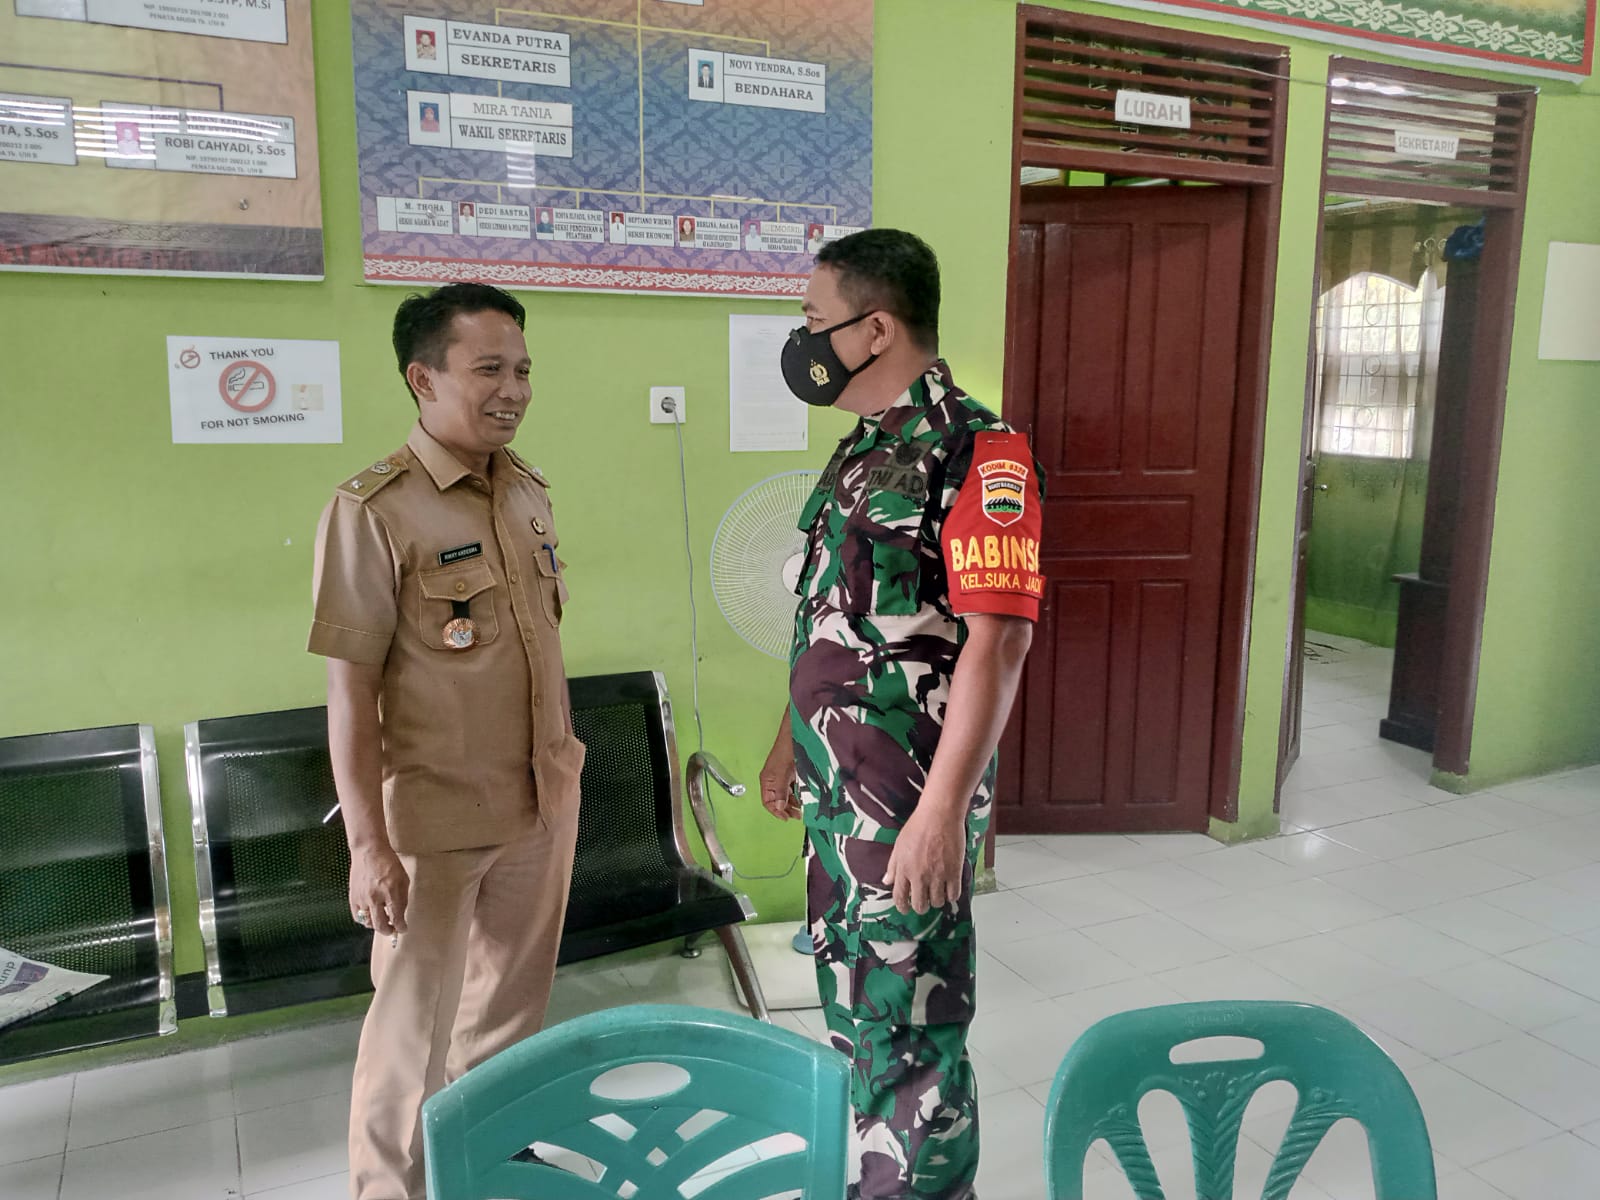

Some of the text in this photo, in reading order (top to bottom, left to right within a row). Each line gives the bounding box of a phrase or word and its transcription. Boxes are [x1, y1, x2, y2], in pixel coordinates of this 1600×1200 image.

[453, 28, 562, 51] EVANDA PUTRA
[461, 54, 557, 74] SEKRETARIS
[729, 59, 820, 79] NOVI YENDRA, S.Sos
[735, 82, 814, 100] BENDAHARA
[473, 102, 553, 120] MIRA TANIA
[1123, 98, 1183, 122] LURAH
[24, 126, 59, 139] S.Sos
[459, 124, 567, 145] WAKIL SEKRETARIS
[165, 136, 287, 157] ROBI CAHYADI, S.Sos
[1398, 135, 1456, 154] SEKRETARIS
[478, 207, 498, 216] DEDI
[209, 348, 275, 361] THANK YOU
[200, 412, 305, 430] FOR NOT SMOKING
[950, 535, 1040, 576] BABINS
